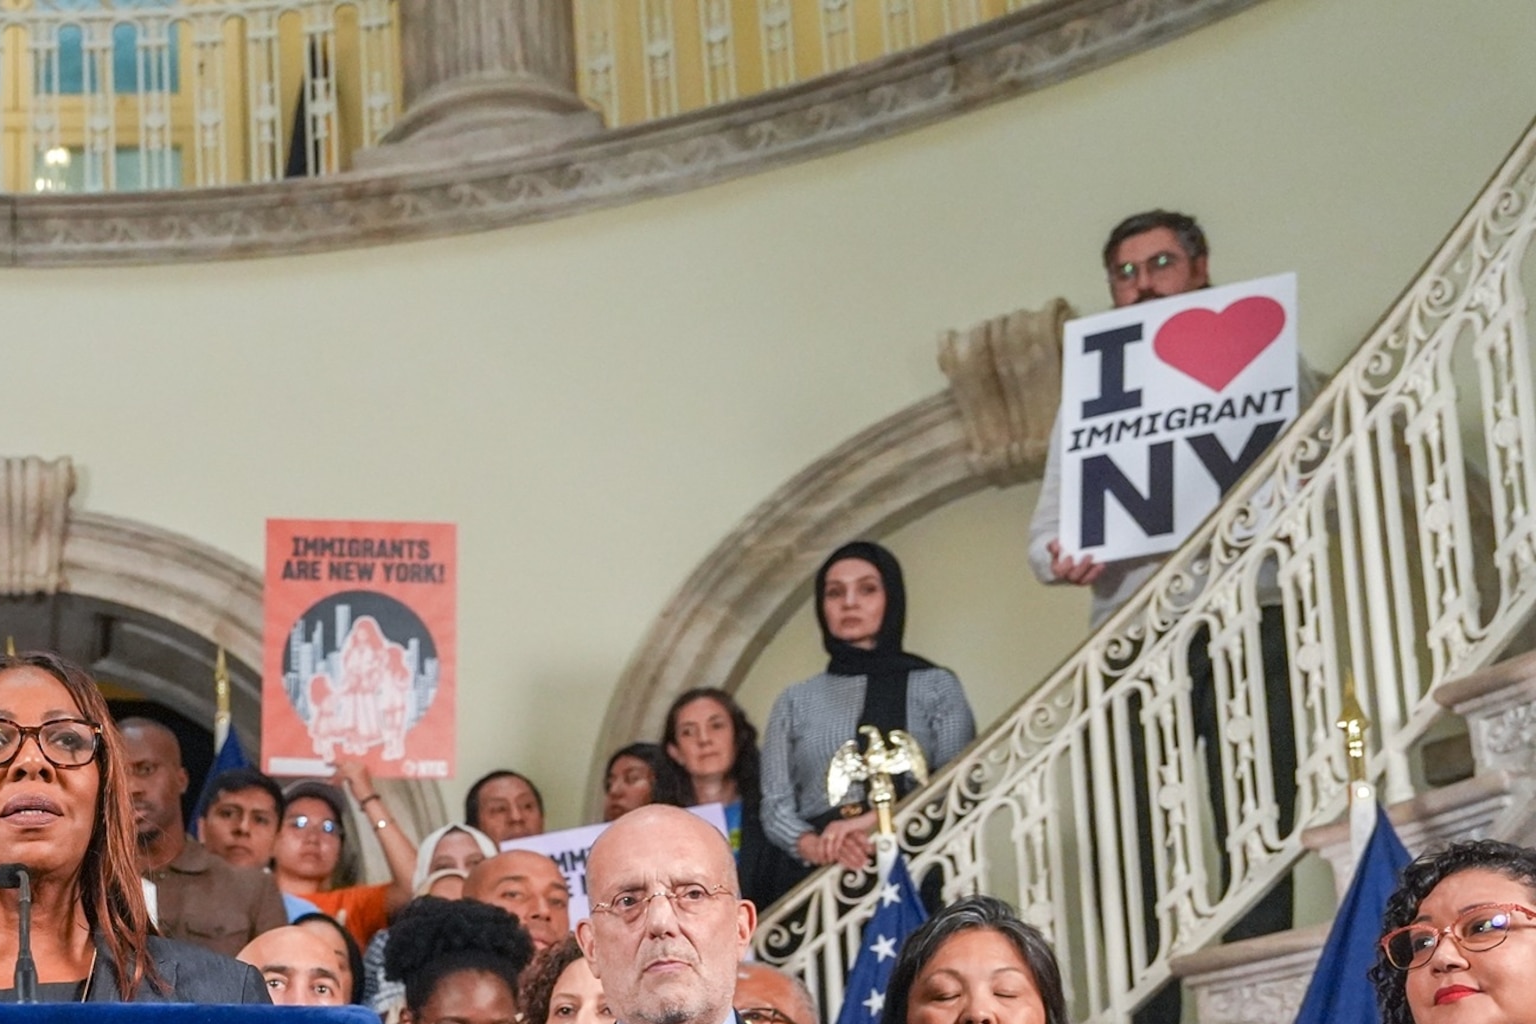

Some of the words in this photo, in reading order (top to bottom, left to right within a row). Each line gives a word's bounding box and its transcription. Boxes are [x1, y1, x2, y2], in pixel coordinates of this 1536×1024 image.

[1081, 322, 1144, 420] I
[1067, 387, 1292, 453] IMMIGRANT
[1079, 418, 1287, 550] NY
[282, 560, 321, 581] ARE
[328, 562, 376, 582] NEW
[383, 563, 446, 584] YORK!
[292, 536, 430, 560] IMMIGRANTS
